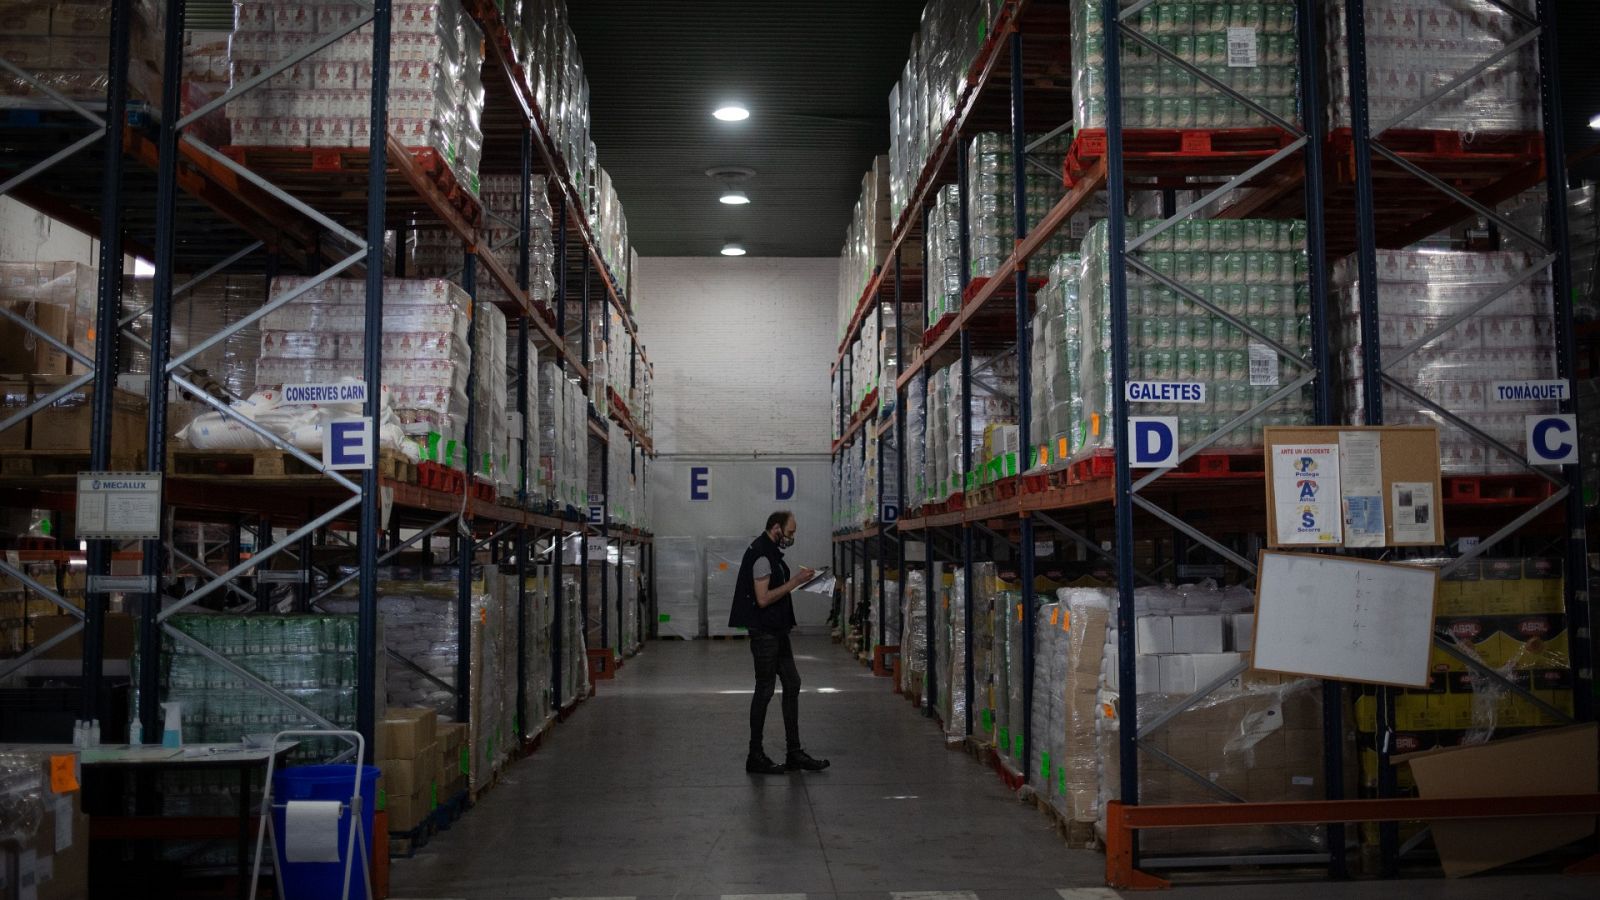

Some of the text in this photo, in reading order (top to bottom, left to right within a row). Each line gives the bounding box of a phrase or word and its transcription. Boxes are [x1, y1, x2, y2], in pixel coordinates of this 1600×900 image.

[286, 385, 364, 401] CONSERVES CARN
[1129, 383, 1201, 400] GALETES
[1498, 382, 1564, 400] TOMÀQUET
[331, 421, 365, 465] E
[1135, 421, 1173, 463] D
[1532, 418, 1572, 460] C
[103, 481, 146, 489] MECALUX
[690, 467, 709, 500] E
[775, 467, 795, 500] D
[1300, 480, 1314, 497] A
[590, 507, 601, 522] E
[884, 506, 898, 520] D
[1302, 512, 1315, 528] S
[1521, 622, 1548, 633] ABRIL
[1396, 738, 1416, 749] BRIL
